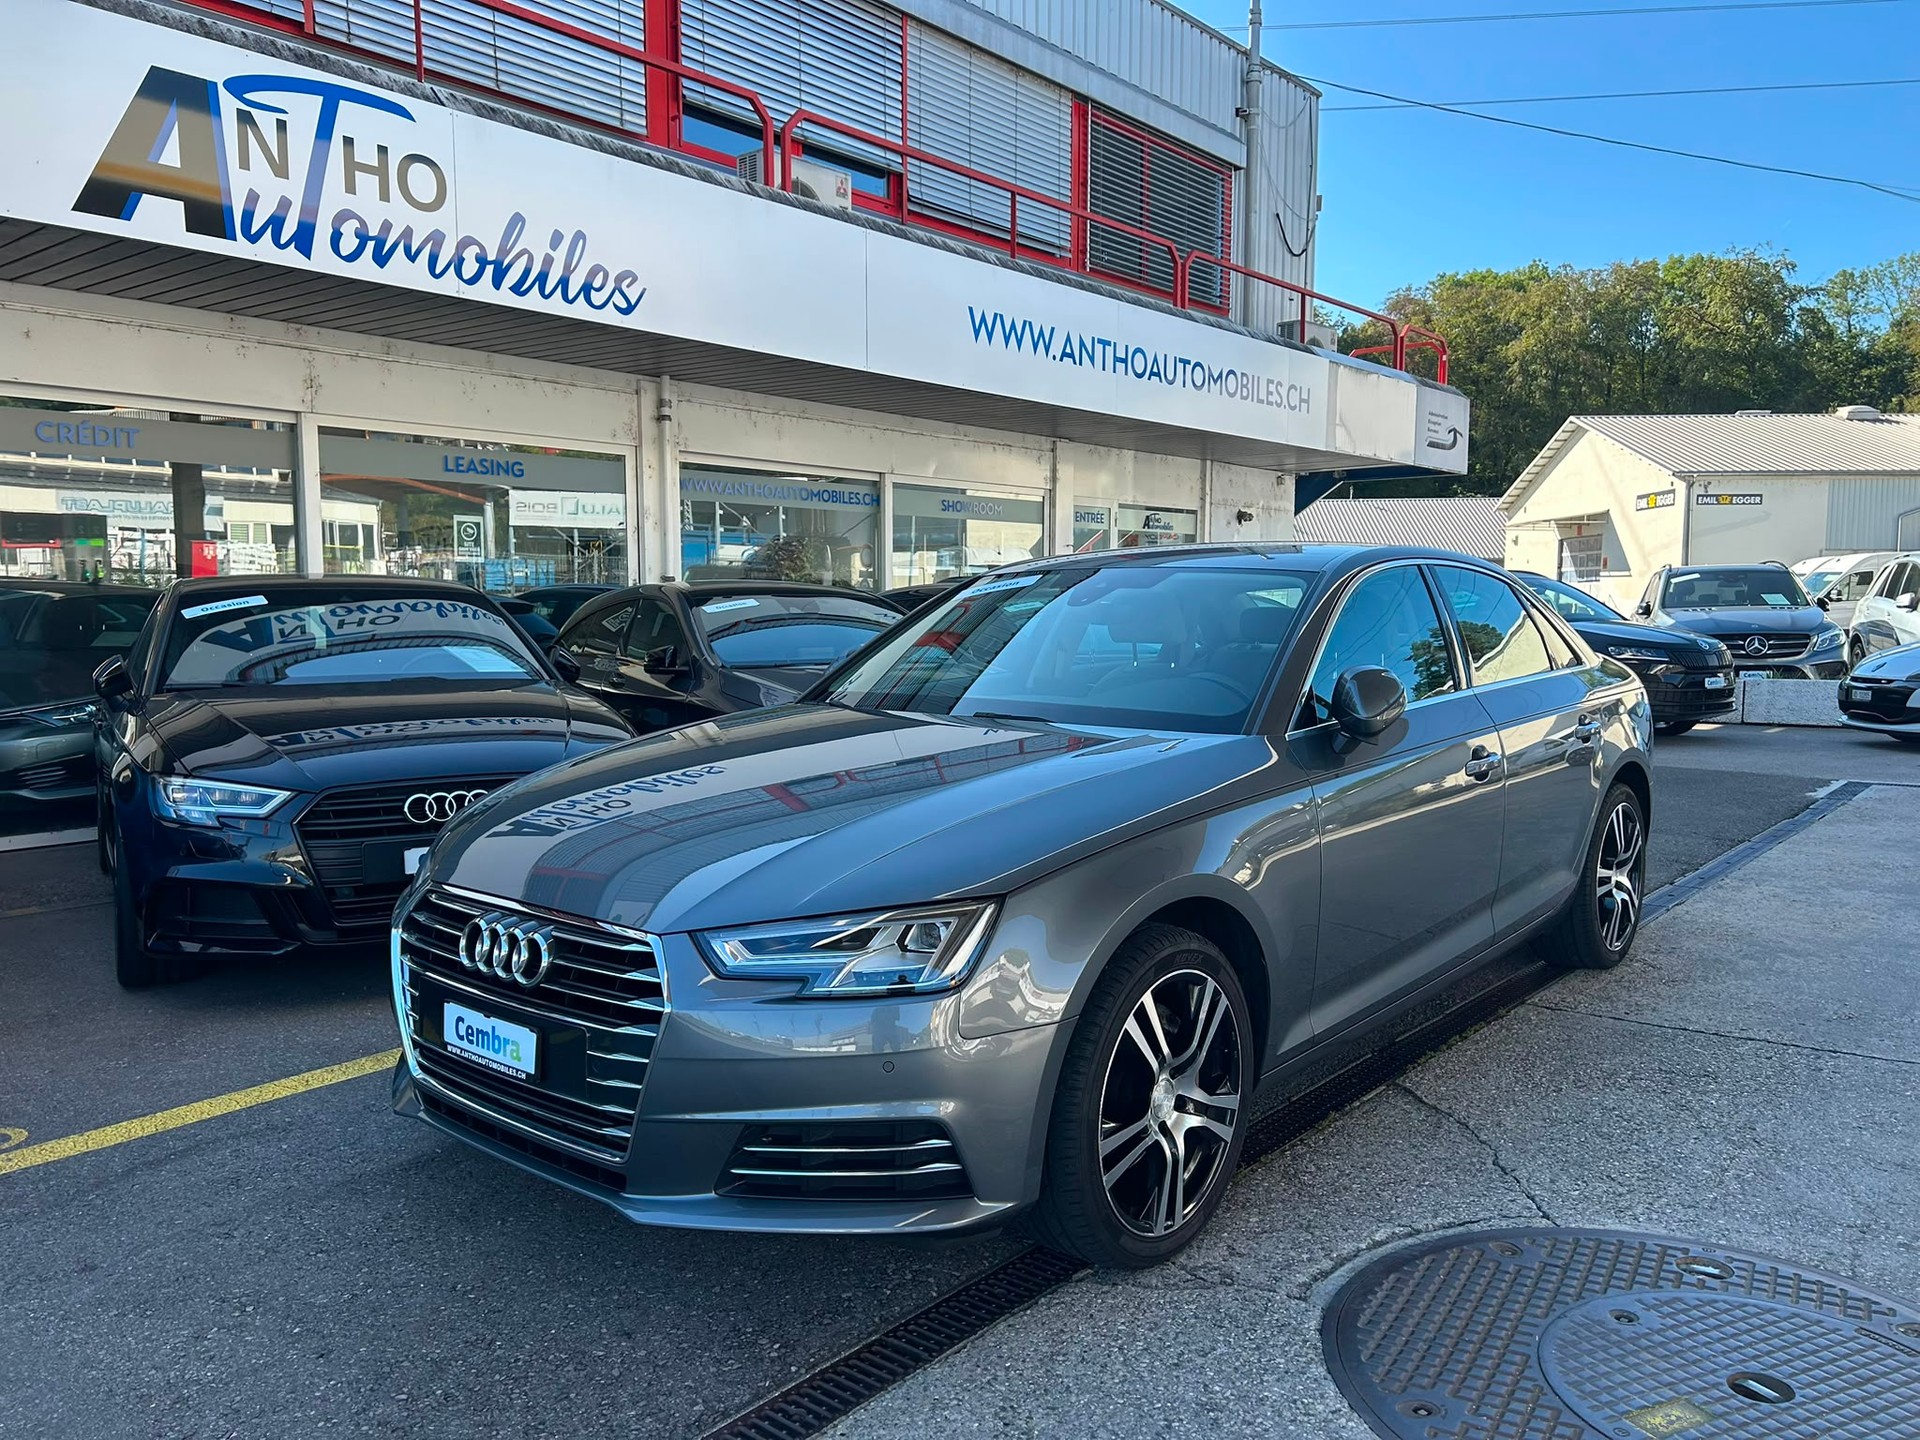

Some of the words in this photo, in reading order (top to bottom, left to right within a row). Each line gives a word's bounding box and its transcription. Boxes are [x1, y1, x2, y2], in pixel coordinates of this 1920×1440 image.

[968, 306, 1311, 414] WWW.ANTHOAUTOMOBILES.CH
[35, 420, 140, 448] CRÉDIT
[443, 455, 525, 478] LEASING
[680, 478, 880, 506] WWW.ANTHOAUTOMOBILES.CH
[1698, 496, 1718, 504] EMIL
[1732, 496, 1761, 504] EGGER
[941, 499, 1003, 515] SHOWROOM
[1075, 510, 1105, 524] ENTRÉE
[200, 599, 250, 613] Occasion
[455, 1015, 521, 1062] Cembra
[447, 1044, 527, 1080] WWW.ANTHOAUTOMOBILES.CH
